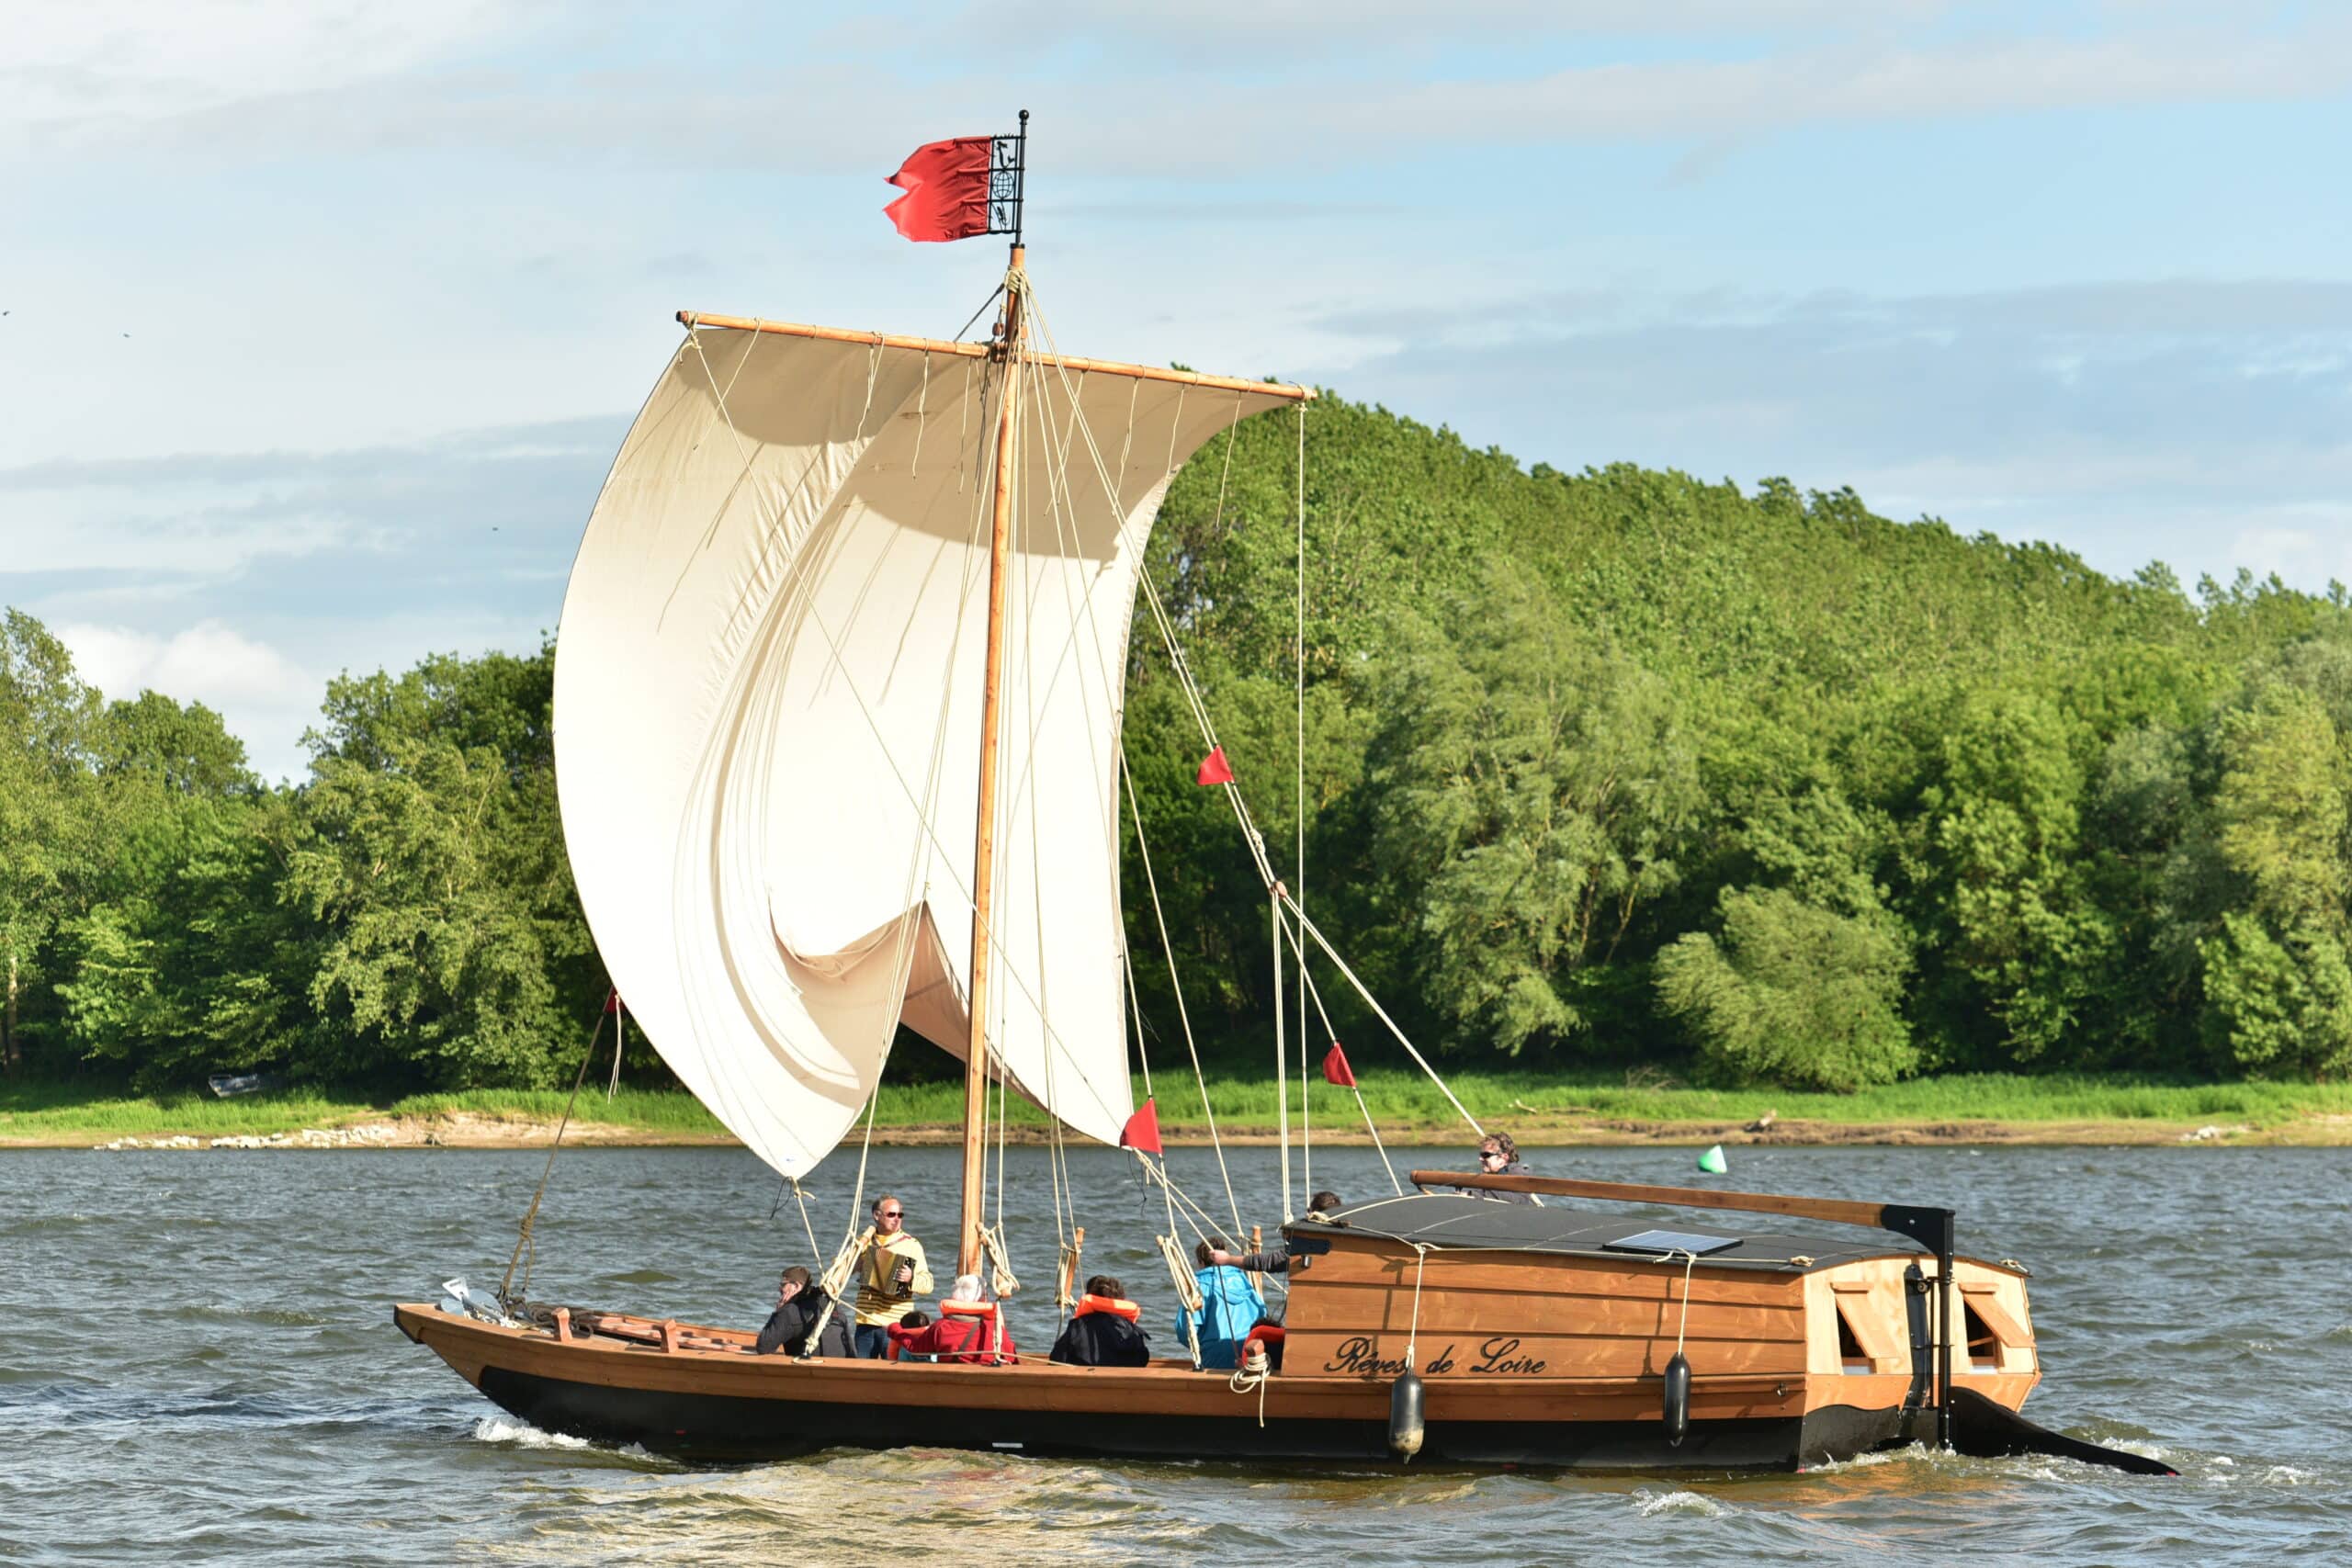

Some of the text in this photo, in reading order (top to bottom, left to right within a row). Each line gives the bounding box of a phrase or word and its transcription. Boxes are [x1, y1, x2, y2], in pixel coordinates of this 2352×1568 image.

[1324, 1337, 1547, 1374] Rêves de Loire
